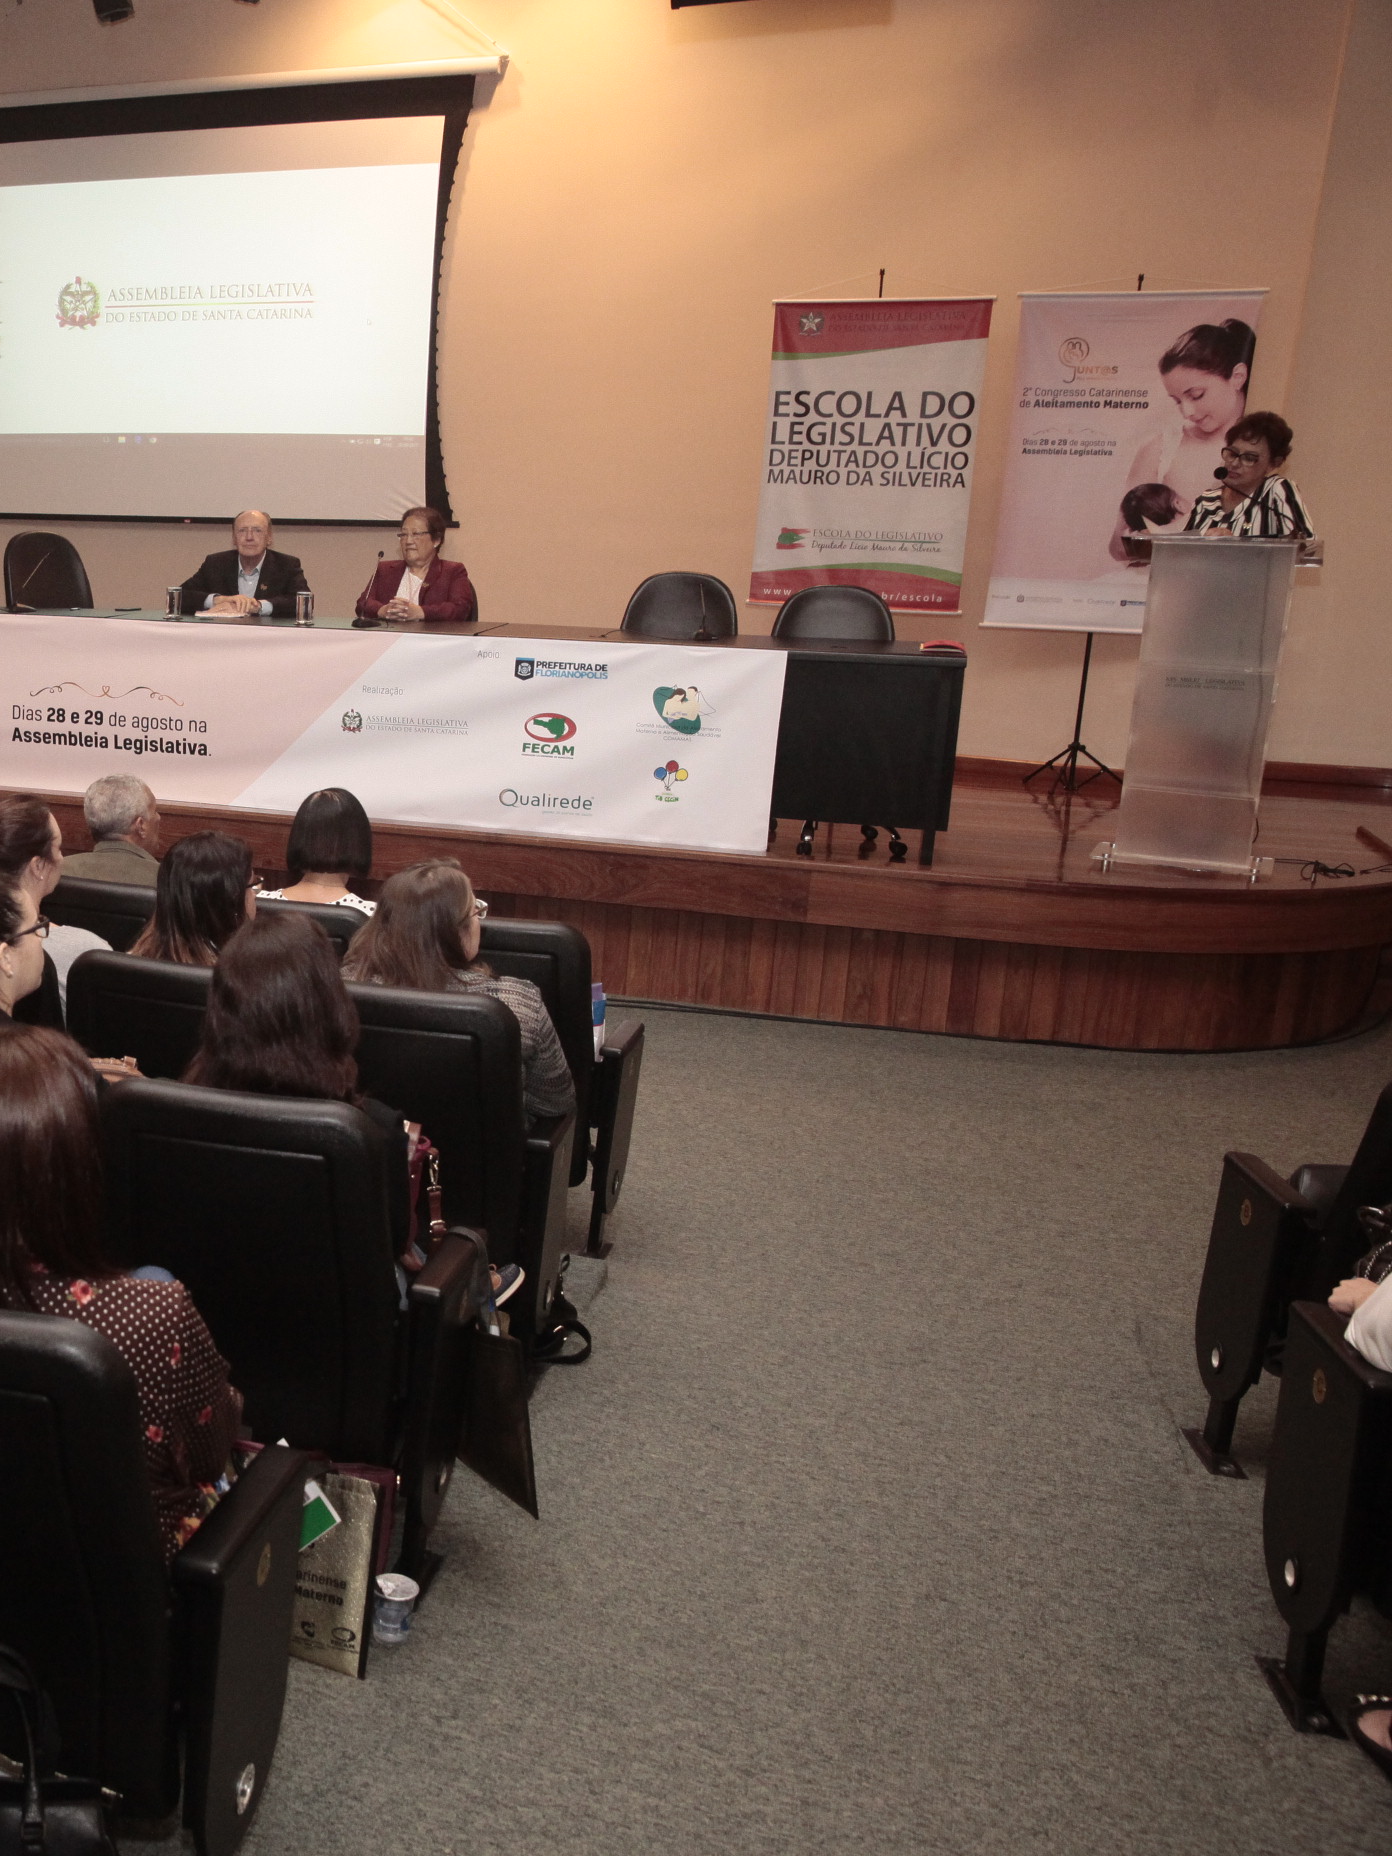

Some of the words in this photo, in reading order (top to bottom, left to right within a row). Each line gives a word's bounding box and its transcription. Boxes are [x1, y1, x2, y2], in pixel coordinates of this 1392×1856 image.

[108, 286, 204, 302] ASSEMBLEIA
[209, 282, 313, 298] LEGISLATIVA
[106, 312, 125, 323] DO
[129, 310, 177, 323] ESTADO
[182, 310, 198, 321] DE
[202, 309, 243, 321] SANTA
[246, 308, 313, 320] CATARINA
[1034, 387, 1086, 399] Congresso
[1089, 388, 1148, 398] Catarinense
[773, 390, 908, 419] ESCOLA
[920, 391, 976, 419] DO
[1019, 399, 1031, 408] de
[1033, 398, 1101, 409] Aleitamento
[1103, 400, 1149, 409] Materno
[770, 421, 972, 448] LEGISLATIVO
[1022, 438, 1038, 446] Dias
[1039, 438, 1049, 446] 28
[1057, 438, 1067, 446] 29
[1080, 440, 1105, 448] agosto
[769, 449, 899, 469] DEPUTADO
[906, 447, 969, 471] LÍCIO
[1022, 447, 1067, 455] Assembleia
[1069, 449, 1113, 457] Legislativa
[767, 469, 840, 486] MAURO
[846, 470, 873, 486] DA
[879, 471, 966, 489] SILVEIRA
[813, 529, 851, 538] ESCOLA
[855, 530, 871, 539] DO
[876, 530, 943, 541] LEGISLATIVO
[811, 540, 847, 553] Deputado
[477, 650, 500, 659] Apoio
[536, 661, 593, 671] PREFEITURA
[594, 664, 608, 672] DE
[362, 685, 404, 696] Realização
[12, 705, 42, 722] Dias
[46, 707, 66, 723] 28
[70, 711, 80, 724] e
[84, 709, 103, 726] 29
[108, 711, 126, 727] de
[131, 715, 183, 733] agosto
[188, 719, 207, 733] na
[367, 715, 415, 725] ASSEMBLEIA
[417, 718, 468, 727] LEGISLATIVA
[12, 727, 108, 749] Assembleia
[114, 734, 212, 757] Legislativa.
[522, 742, 575, 756] FECAM
[499, 788, 593, 810] Qualirede
[296, 1570, 346, 1590] arinense
[294, 1584, 343, 1606] Materno
